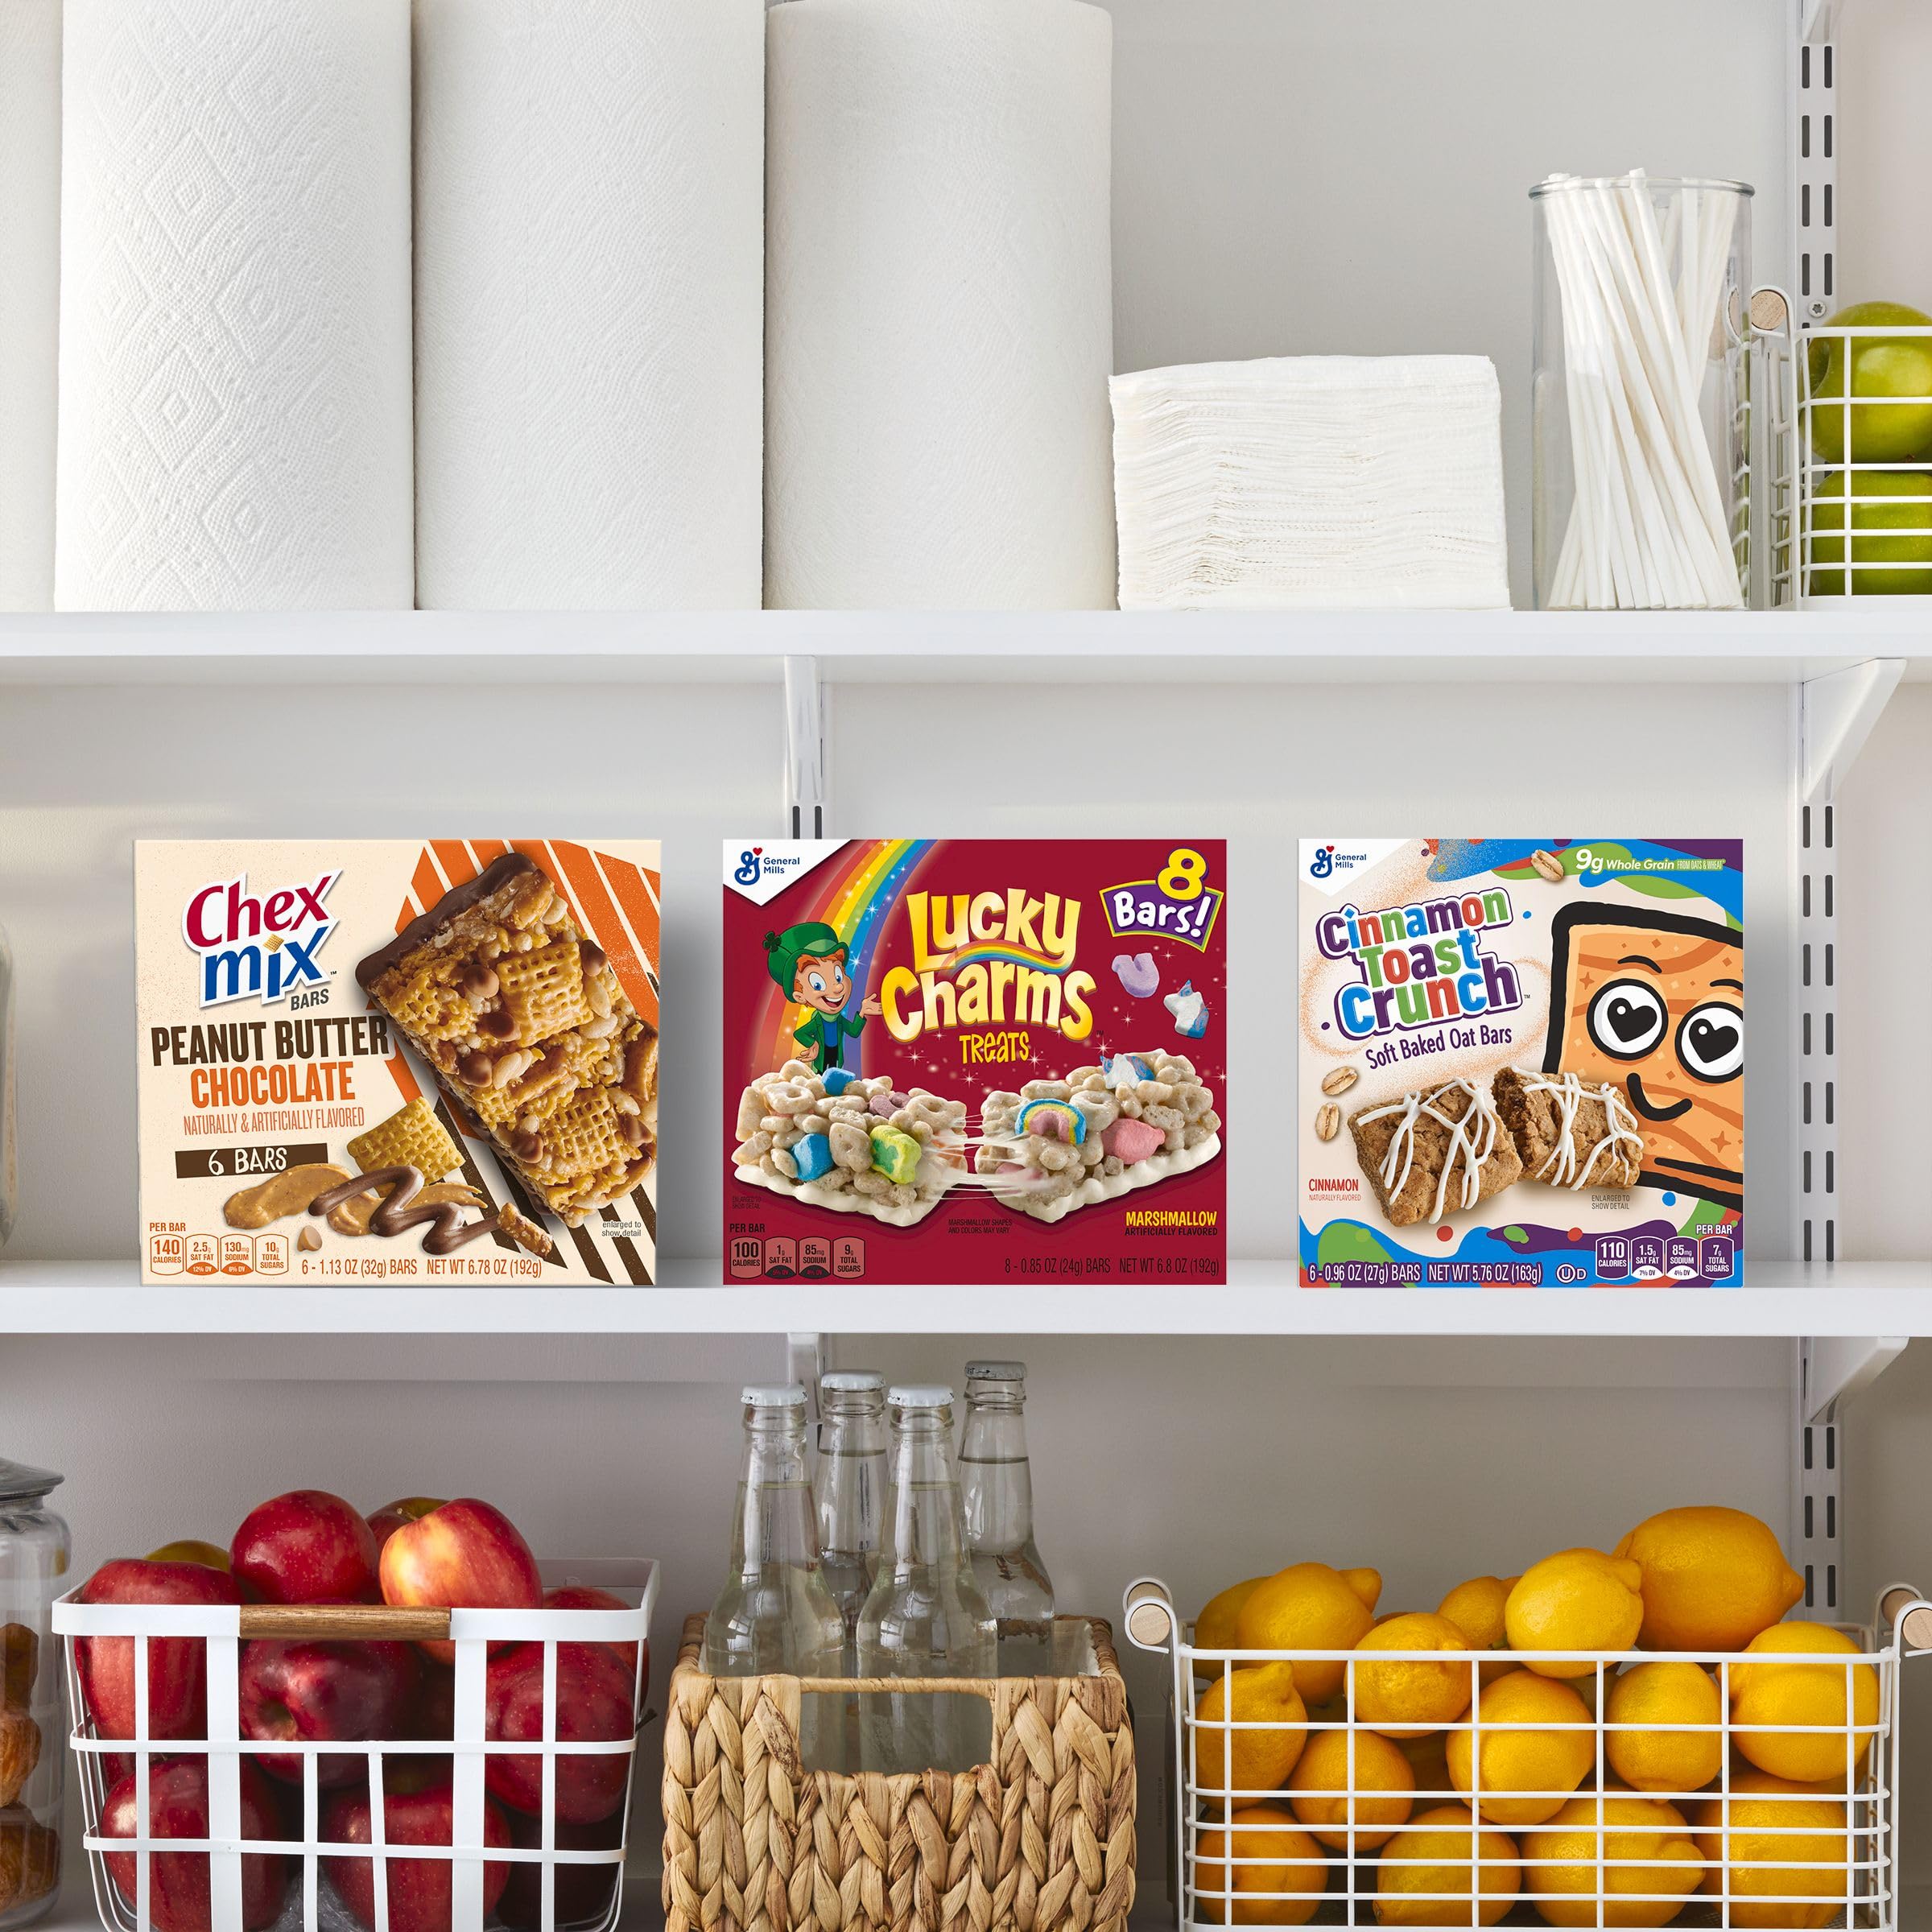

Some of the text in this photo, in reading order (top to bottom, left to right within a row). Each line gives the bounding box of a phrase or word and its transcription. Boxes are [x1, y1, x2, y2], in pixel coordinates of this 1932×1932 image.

[1575, 848, 1604, 874] 9g
[1606, 859, 1641, 869] Whole
[1643, 859, 1674, 869] Grain
[1157, 848, 1207, 901] 8
[186, 875, 332, 947] Chex
[1113, 890, 1212, 938] Bars!
[906, 887, 1082, 974] Lucky
[1323, 891, 1509, 952] Cinnamon
[204, 926, 329, 1001] mix
[1359, 929, 1481, 988] Toast
[291, 989, 329, 1011] BARS
[881, 960, 1097, 1043] Charms
[1341, 956, 1518, 1034] Crunch
[151, 1015, 389, 1066] PEANUT BUTTER
[1365, 1025, 1512, 1070] Soft Baked Oat Bars
[191, 1061, 356, 1108] CHOCOLATE
[184, 1107, 365, 1136] NATURALLY & ARTIFICIALLY FLAVORED
[208, 1147, 287, 1175] 6 BARS
[1308, 1179, 1359, 1191] CINNAMON
[150, 1222, 186, 1232] PER BAR
[602, 1220, 633, 1229] enlarged
[729, 1223, 766, 1232] PER BAR
[1125, 1211, 1217, 1227] MARSHMALLOW
[1696, 1224, 1732, 1234] PER BAR
[1125, 1228, 1218, 1236] ARTIFICIALLY FLAVORED
[154, 1239, 180, 1255] 140
[733, 1241, 759, 1258] 100
[1600, 1241, 1625, 1258] 110
[153, 1256, 182, 1264] CALORIES
[301, 1259, 308, 1274] 6
[320, 1259, 341, 1274] 1.13
[345, 1259, 358, 1274] OZ
[361, 1259, 386, 1278] (32g)
[390, 1259, 418, 1274] BARS
[427, 1259, 543, 1278] NET WT 6.78 OZ (192g)
[837, 1265, 861, 1273] SUGARS
[1005, 1257, 1010, 1274] 8
[1021, 1257, 1042, 1274] 0.85
[1044, 1257, 1057, 1274] OZ
[1059, 1257, 1083, 1276] (24g)
[1087, 1257, 1111, 1274] BARS
[1119, 1257, 1220, 1276] NET WT 6.8 OZ (192g)
[1598, 1259, 1627, 1267] CALORIES
[1309, 1265, 1315, 1282] 6
[1325, 1265, 1344, 1282] 0.96
[1348, 1265, 1361, 1282] OZ
[1364, 1265, 1389, 1285] (27g)
[1391, 1265, 1420, 1282] BARS
[1429, 1265, 1542, 1285] NET WT 5.76 OZ (163g)
